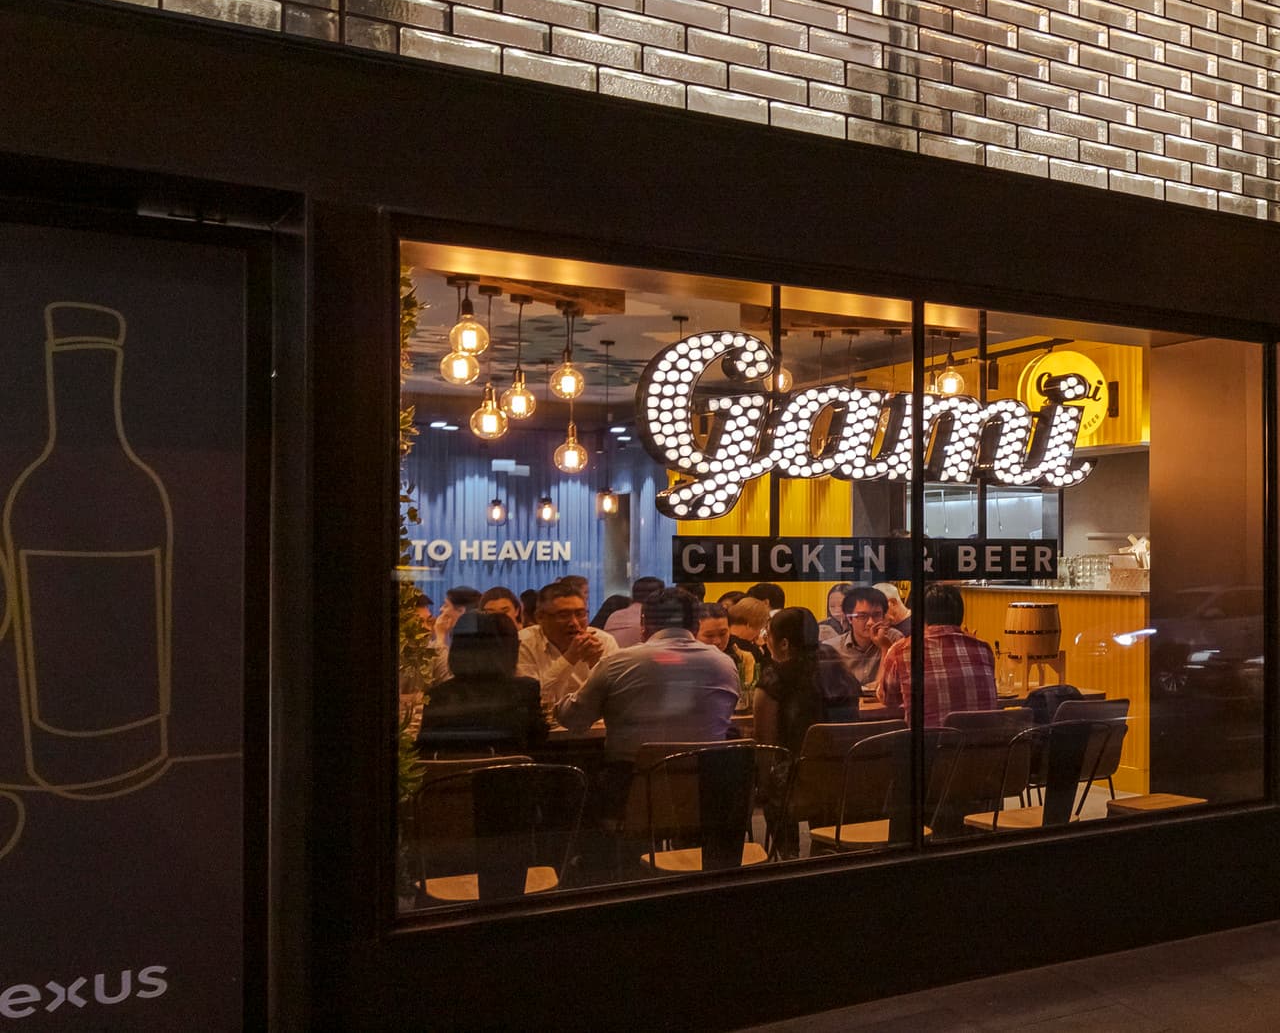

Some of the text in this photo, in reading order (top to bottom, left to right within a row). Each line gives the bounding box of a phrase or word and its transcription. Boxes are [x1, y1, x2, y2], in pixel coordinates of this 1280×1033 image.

[637, 330, 1098, 521] Gami
[411, 539, 571, 561] TO HEAVEN
[682, 543, 886, 574] CHICKEN
[957, 545, 1053, 573] BEER
